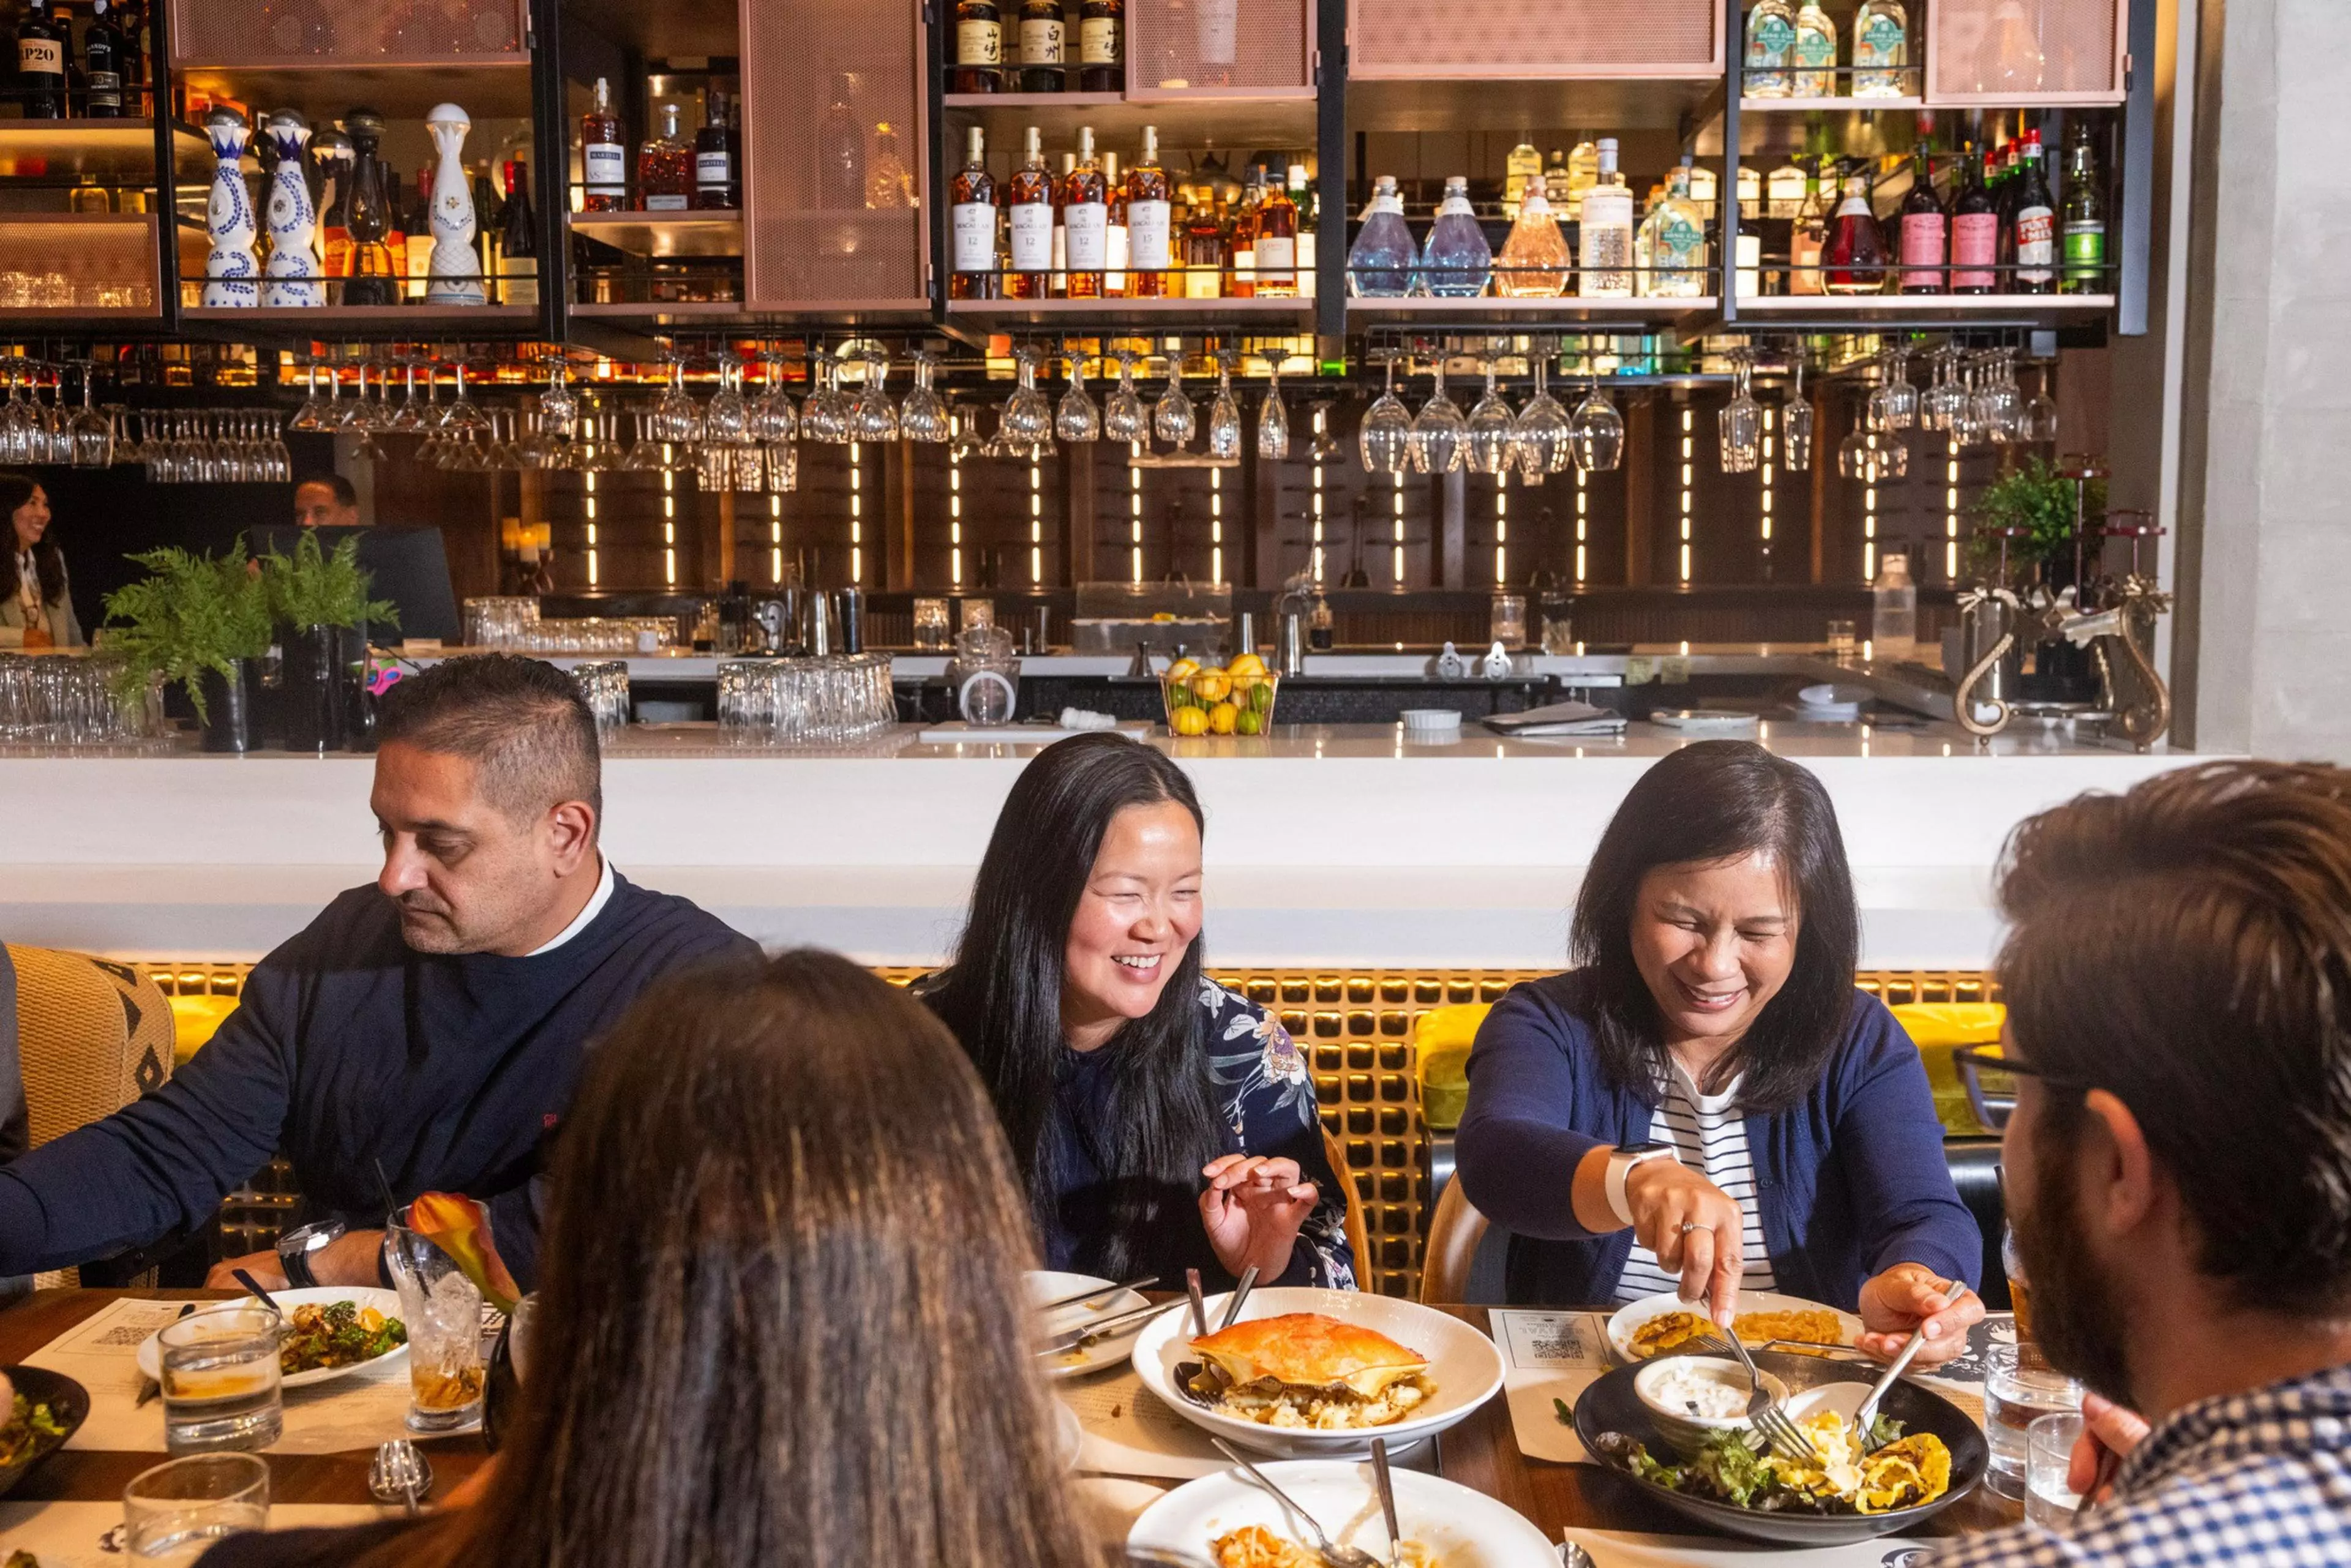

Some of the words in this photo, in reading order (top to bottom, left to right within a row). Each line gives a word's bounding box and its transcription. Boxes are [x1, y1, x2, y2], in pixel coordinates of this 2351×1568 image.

[968, 237, 978, 246] 12
[1026, 238, 1036, 246] 12
[1079, 237, 1089, 246] 12
